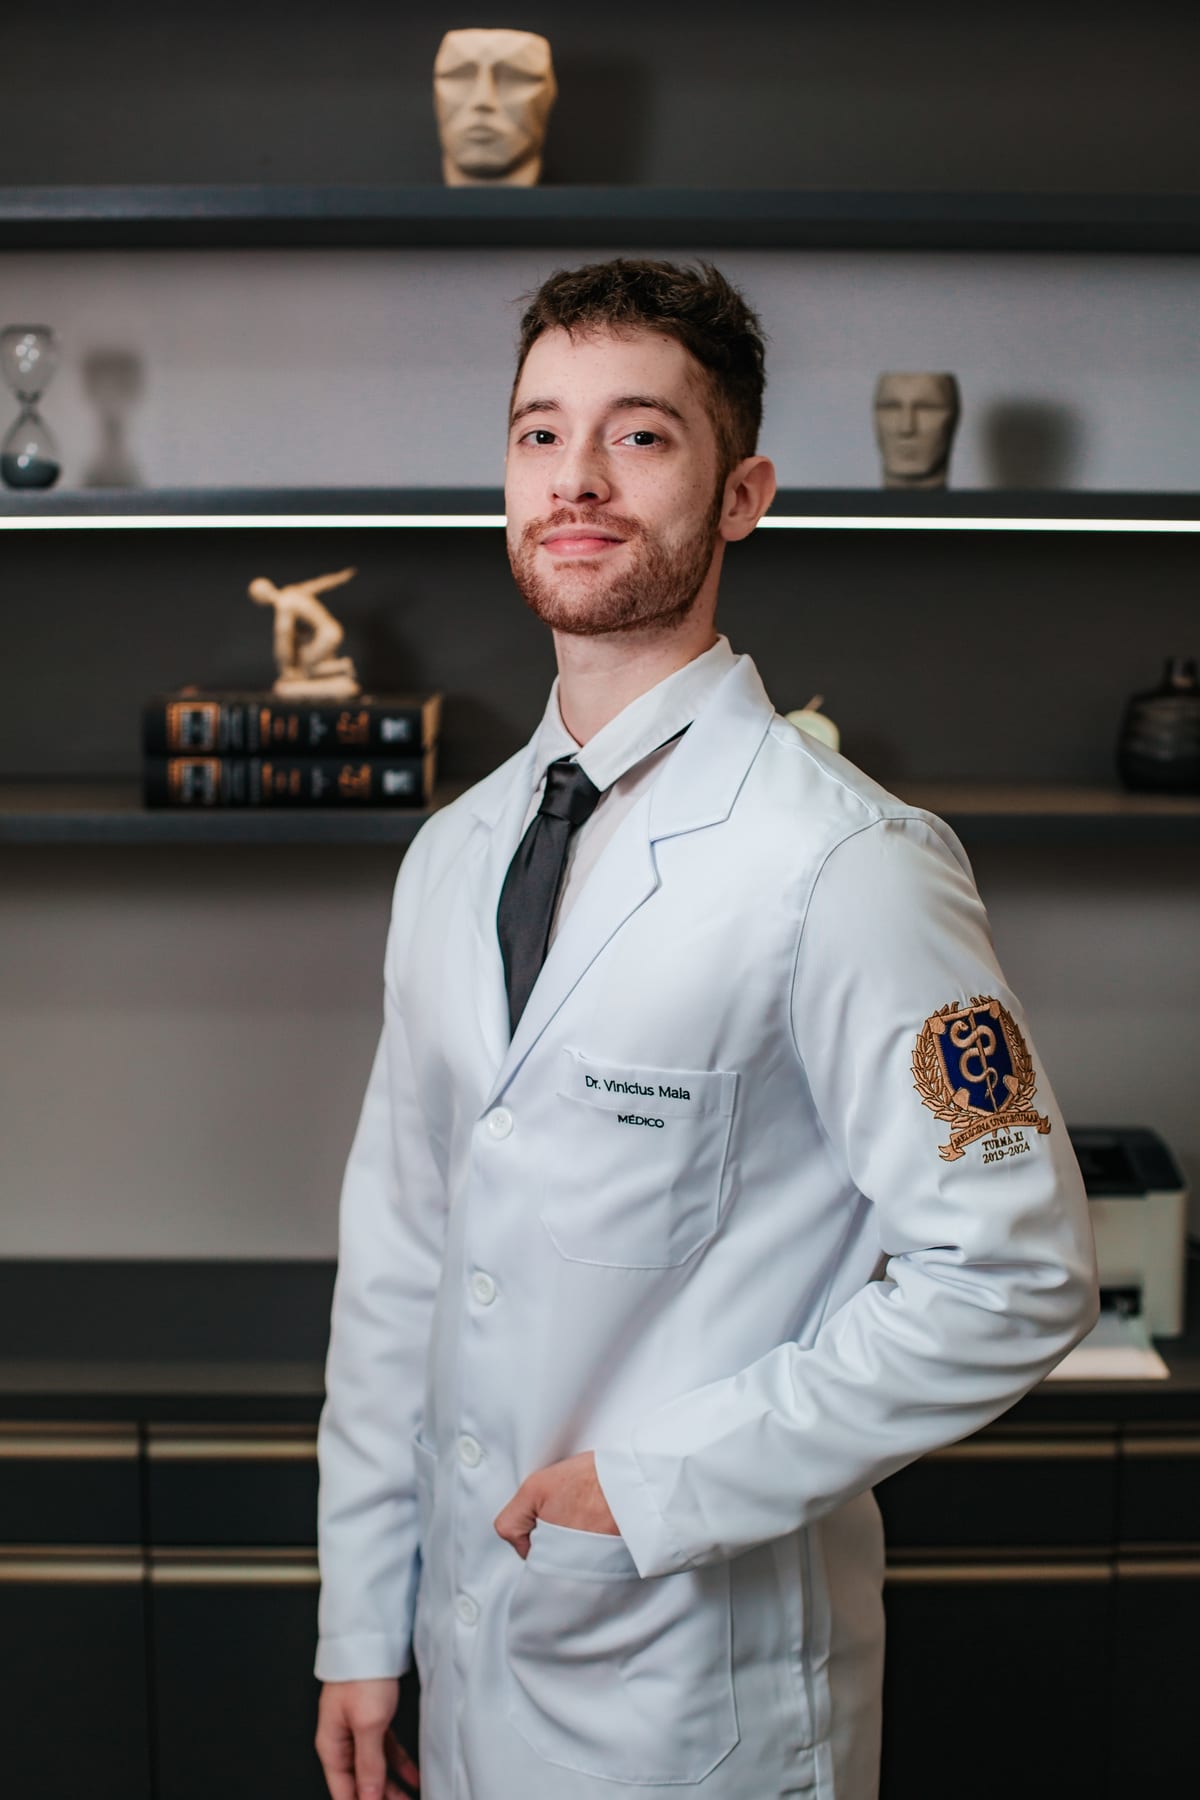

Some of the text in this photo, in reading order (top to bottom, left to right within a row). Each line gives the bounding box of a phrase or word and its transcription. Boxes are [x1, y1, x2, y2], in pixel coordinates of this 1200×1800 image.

[585, 1075, 601, 1090] Dr.
[658, 1085, 691, 1100] Maia
[617, 1114, 665, 1128] MÉDICO
[953, 1122, 990, 1147] MEDICINA
[982, 1131, 1025, 1151] TURMA XI
[982, 1141, 1031, 1164] 2019-2024
